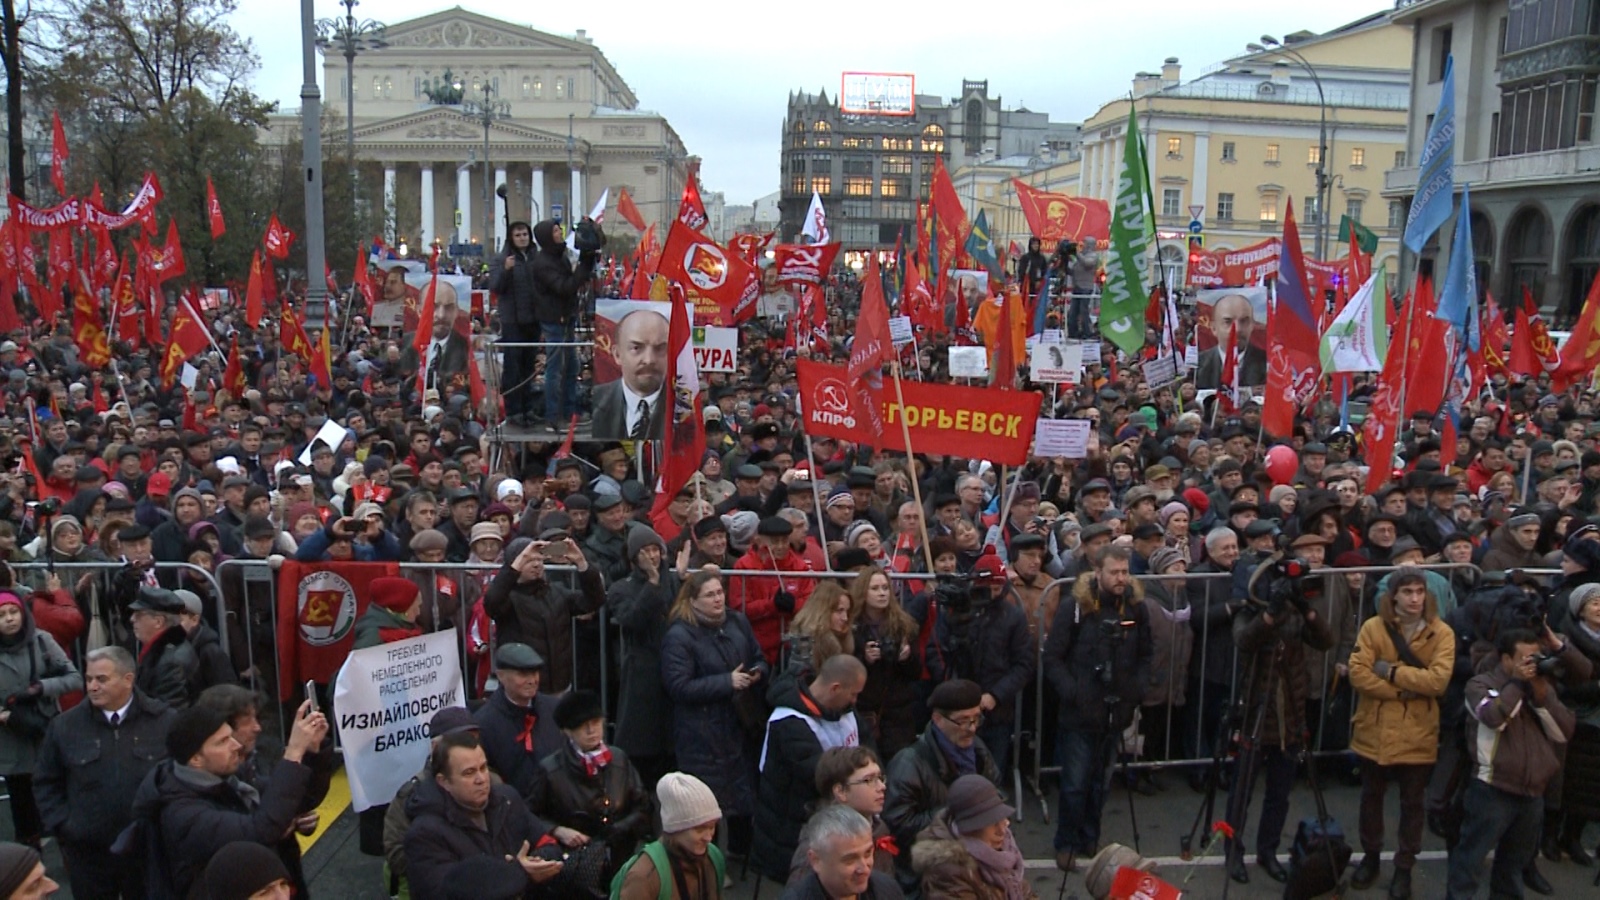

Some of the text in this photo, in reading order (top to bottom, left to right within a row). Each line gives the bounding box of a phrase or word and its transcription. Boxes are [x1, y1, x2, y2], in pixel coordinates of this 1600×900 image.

[812, 409, 856, 430] КПРФ
[386, 642, 427, 661] ТРЕБУЕМ
[371, 654, 443, 683] НЕМЕДЛЕННОГО
[379, 672, 437, 697] РАССЕЛЕНИЯ
[341, 690, 457, 730] ИЗМАЙЛОВСКИХ
[374, 723, 431, 753] БАРАКО
